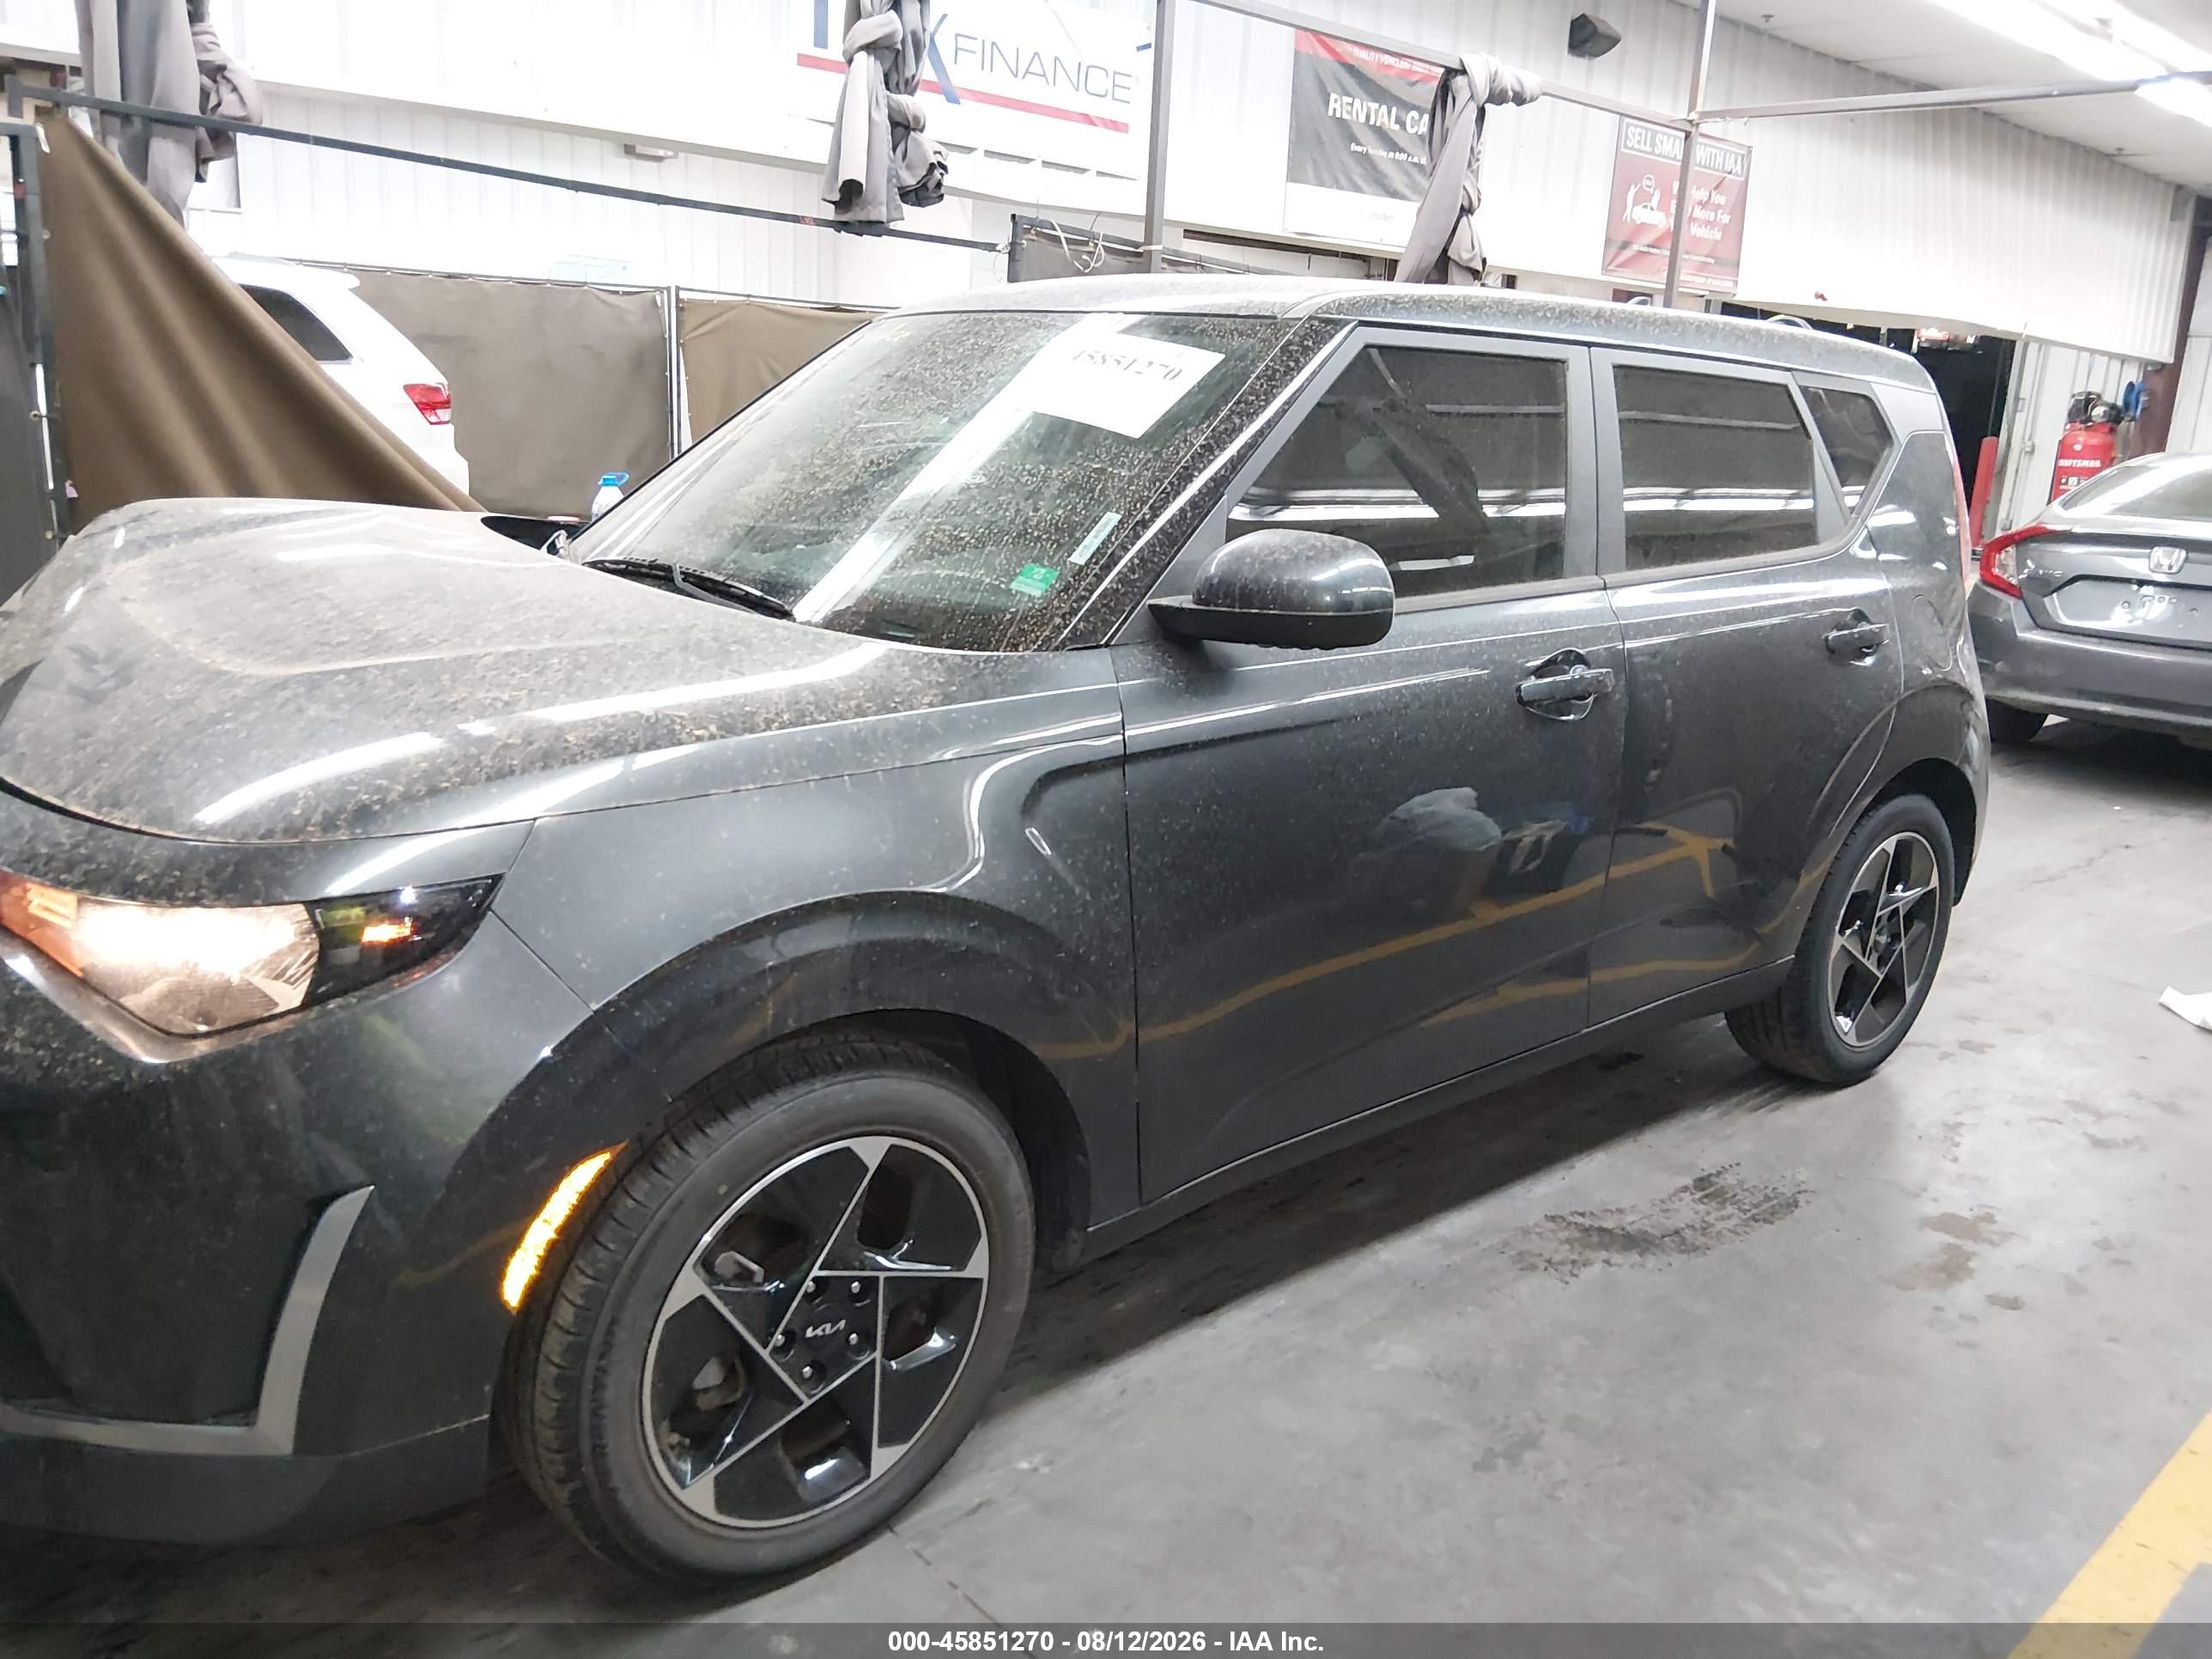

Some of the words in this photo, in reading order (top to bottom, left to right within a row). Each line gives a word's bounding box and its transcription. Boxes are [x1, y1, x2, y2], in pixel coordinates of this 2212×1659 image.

[953, 33, 1133, 104] FINANCE
[1328, 93, 1400, 131] RENTAL
[1407, 110, 1429, 135] CA
[1626, 126, 1652, 151] SELL
[1655, 132, 1682, 161] SMA
[1696, 143, 1723, 170] WITH
[1711, 190, 1727, 205] You
[1692, 205, 1715, 222] More
[1717, 210, 1731, 224] For
[1690, 222, 1723, 240] Vehicle
[805, 1319, 846, 1338] KIA
